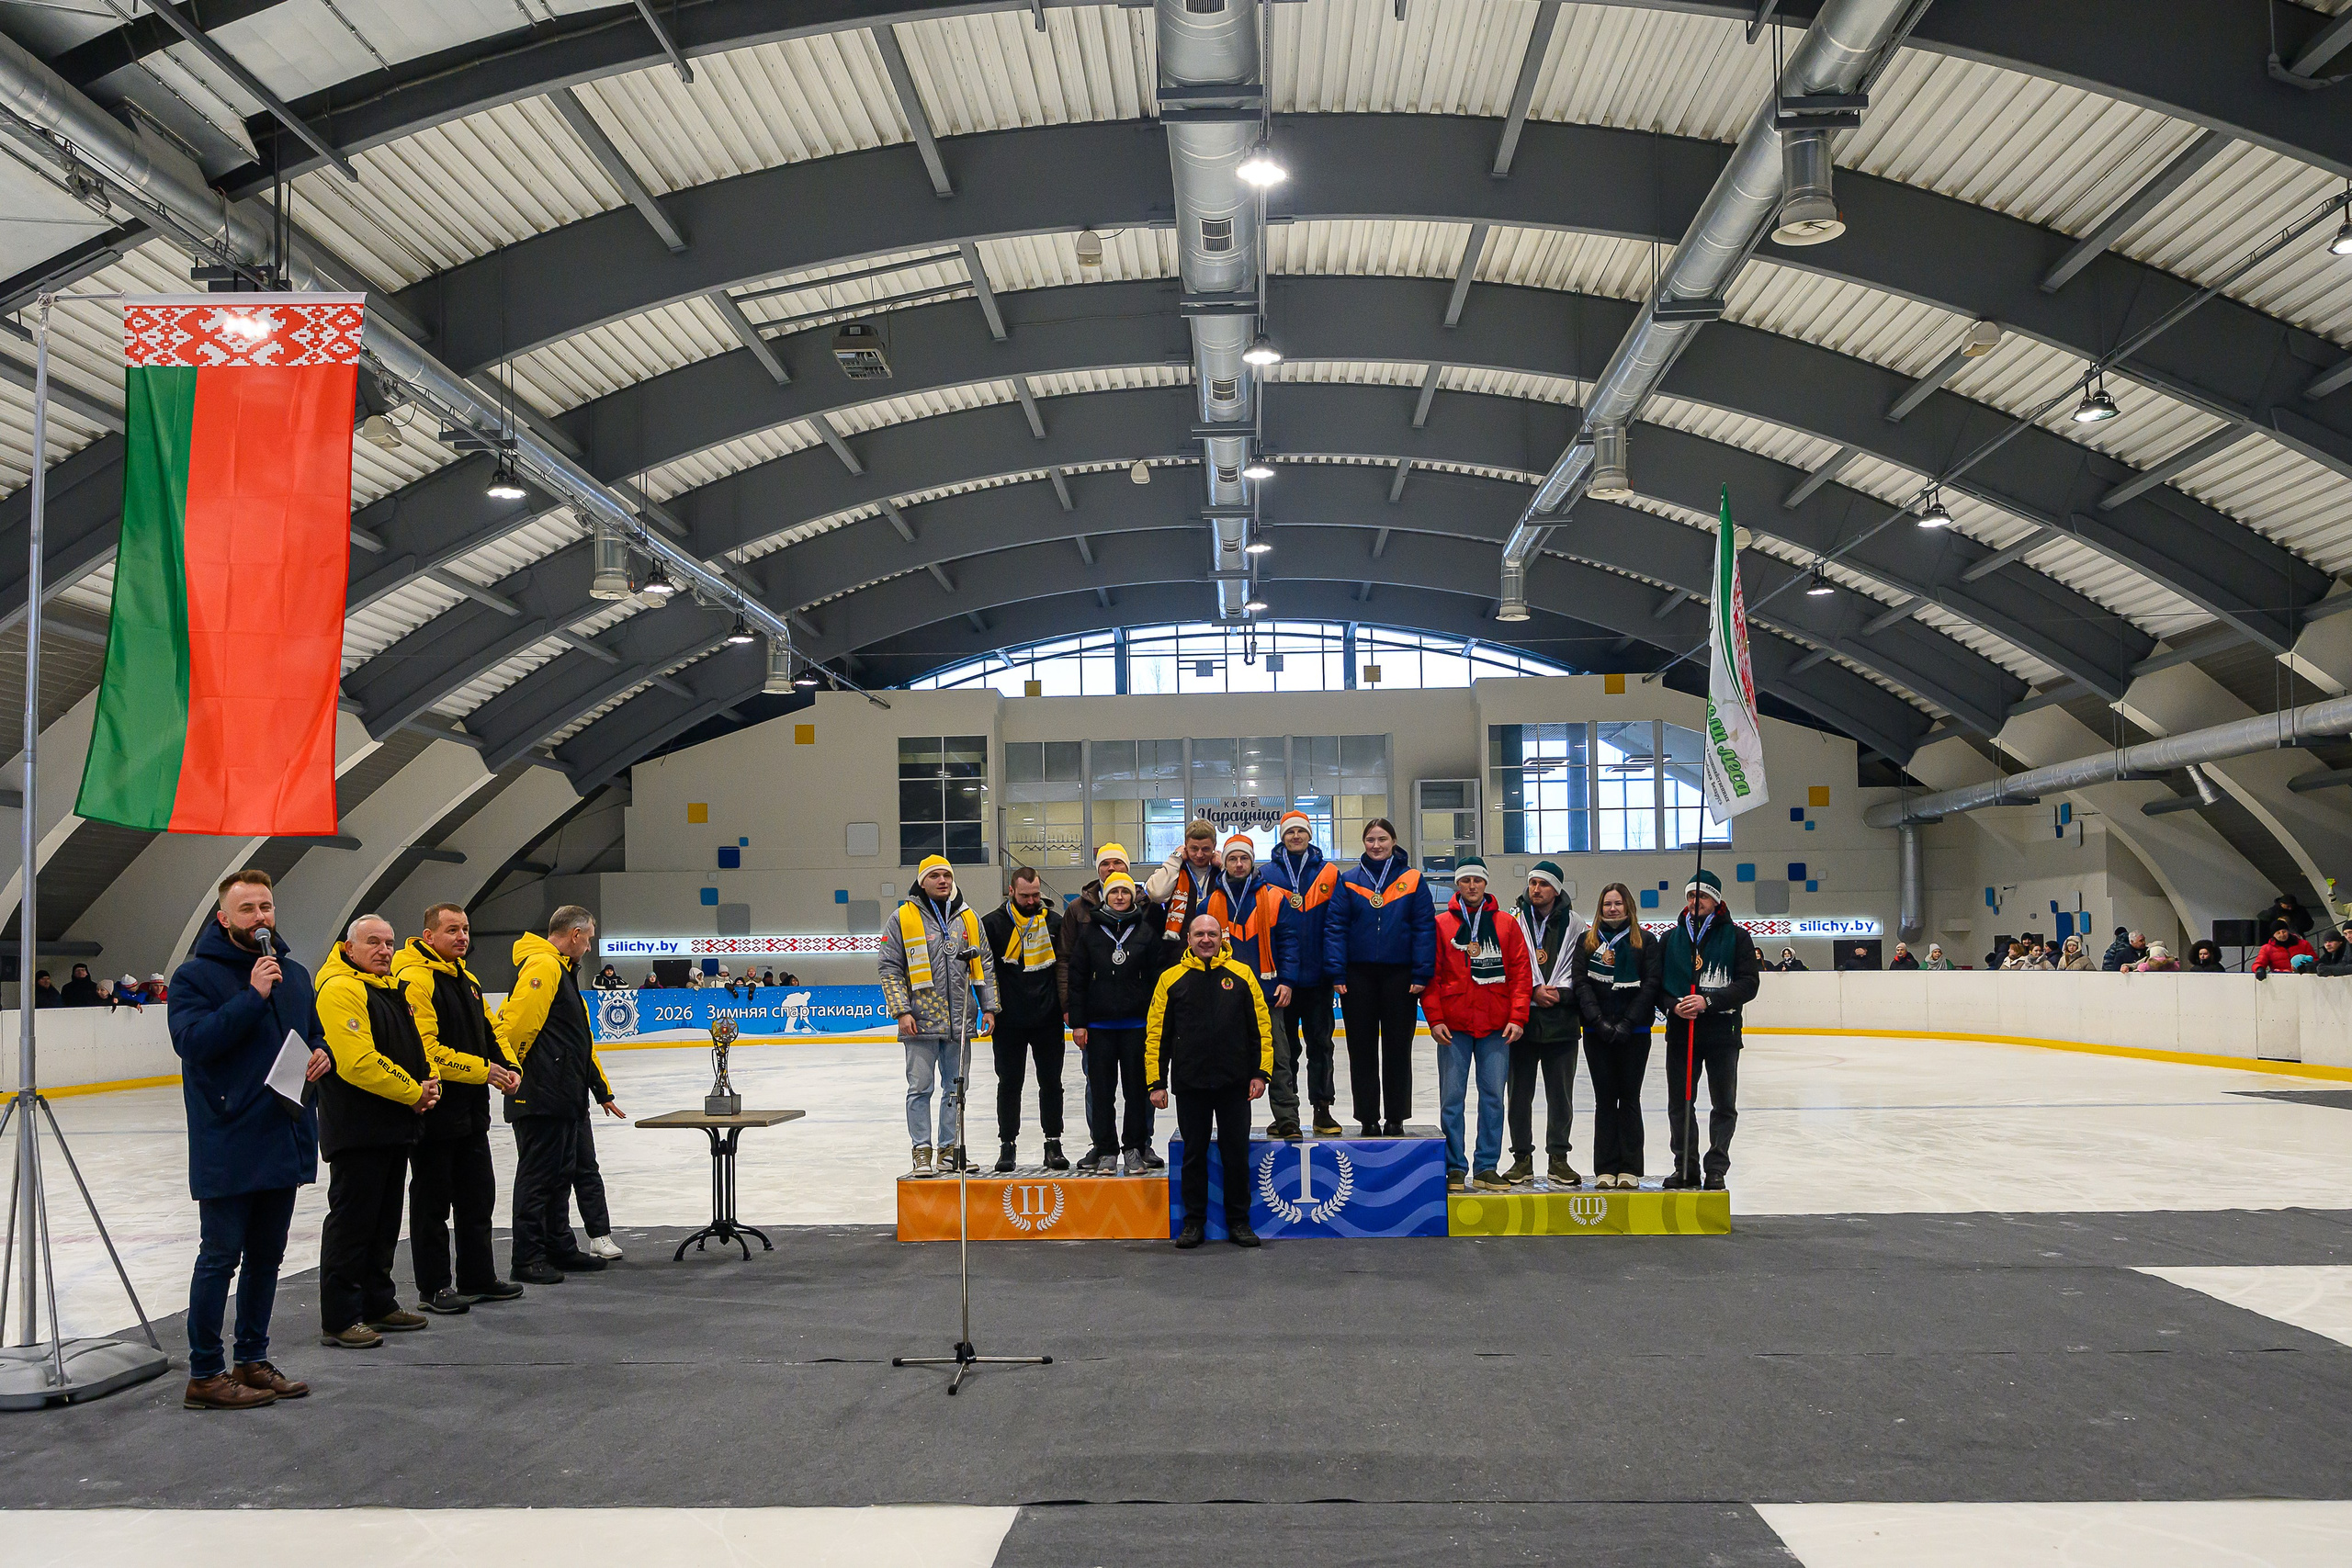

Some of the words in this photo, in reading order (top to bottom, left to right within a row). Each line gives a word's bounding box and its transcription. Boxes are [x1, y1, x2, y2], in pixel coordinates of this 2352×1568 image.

[1717, 745, 1750, 798] леса
[1224, 800, 1256, 808] КАФЕ
[1799, 919, 1875, 933] silichy.by
[607, 940, 679, 953] silichy.by
[654, 1006, 694, 1021] 2026
[707, 1004, 767, 1020] Зимняя
[772, 1004, 873, 1021] спартакиада
[433, 1055, 472, 1073] BELARUS
[1291, 1142, 1320, 1203] I
[1018, 1185, 1048, 1215] II
[1575, 1197, 1600, 1214] III
